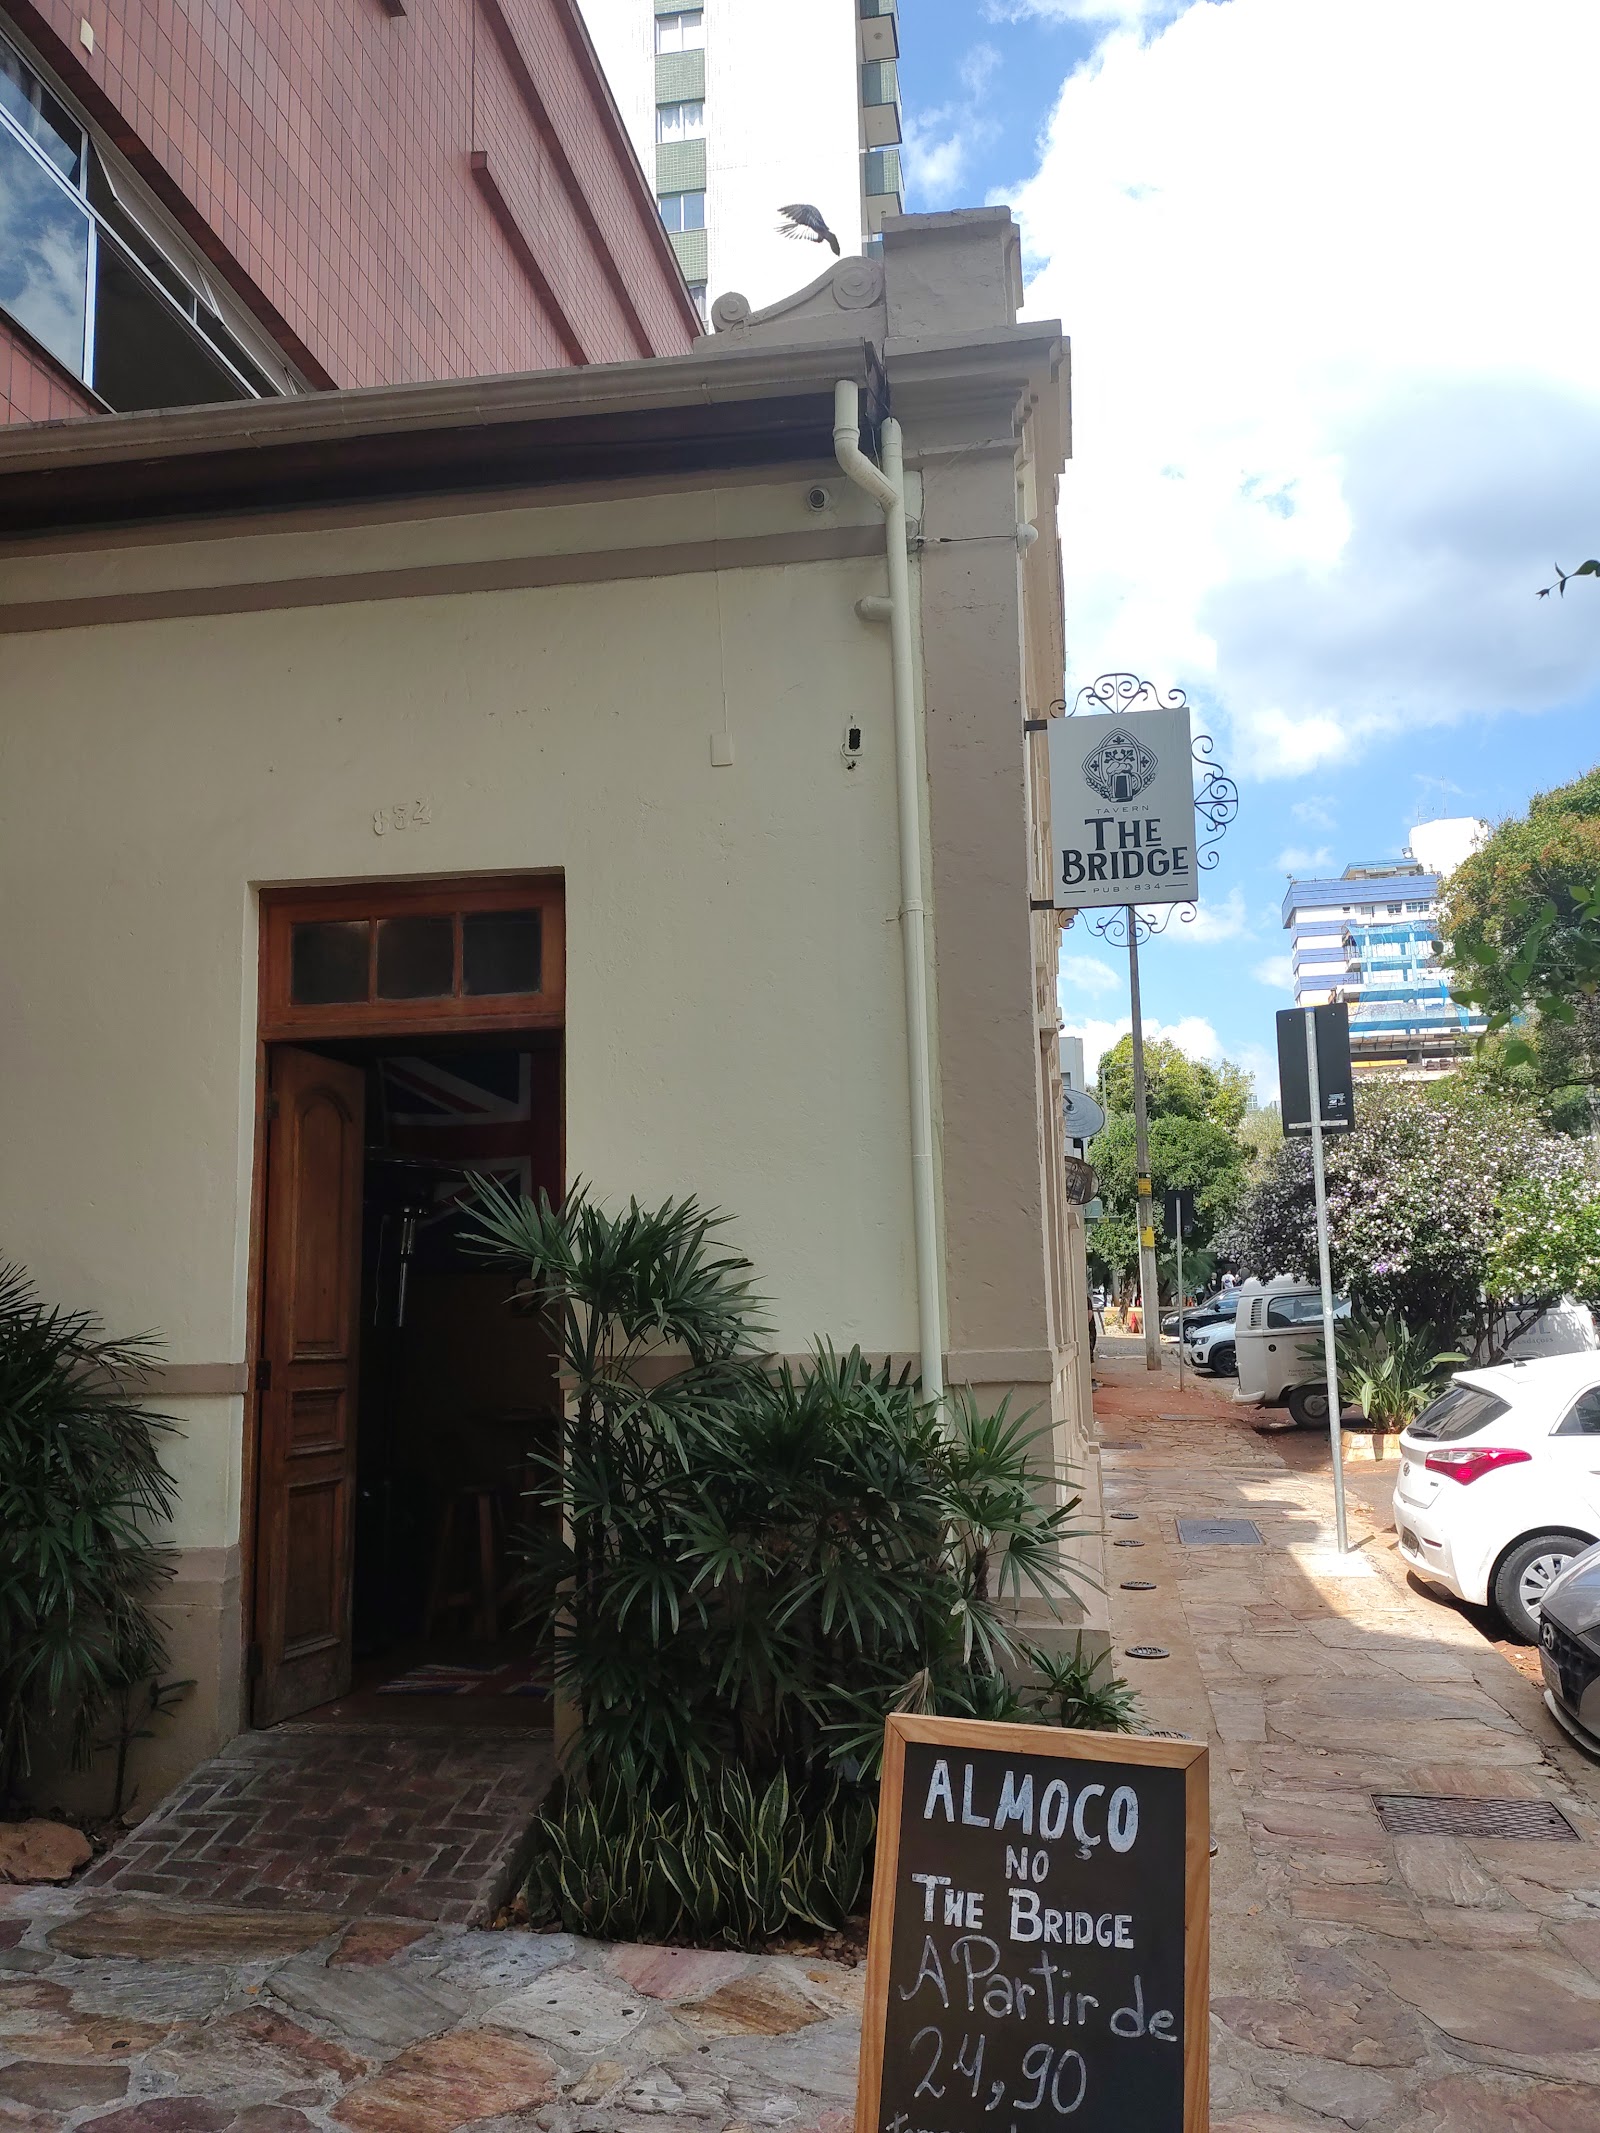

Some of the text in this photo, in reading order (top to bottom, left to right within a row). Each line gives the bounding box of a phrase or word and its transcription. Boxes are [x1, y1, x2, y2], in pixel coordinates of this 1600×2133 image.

[1095, 805, 1150, 815] TAVERN
[1084, 817, 1162, 851] THE
[1061, 846, 1188, 885] BRIDGE
[1093, 883, 1161, 894] PUB 834
[923, 1759, 1139, 1861] ALMOÇO
[1004, 1845, 1049, 1883] NO
[911, 1873, 1134, 1950] THE BRIDGE
[1110, 1975, 1178, 2042] de
[910, 2026, 1087, 2114] 24,90
